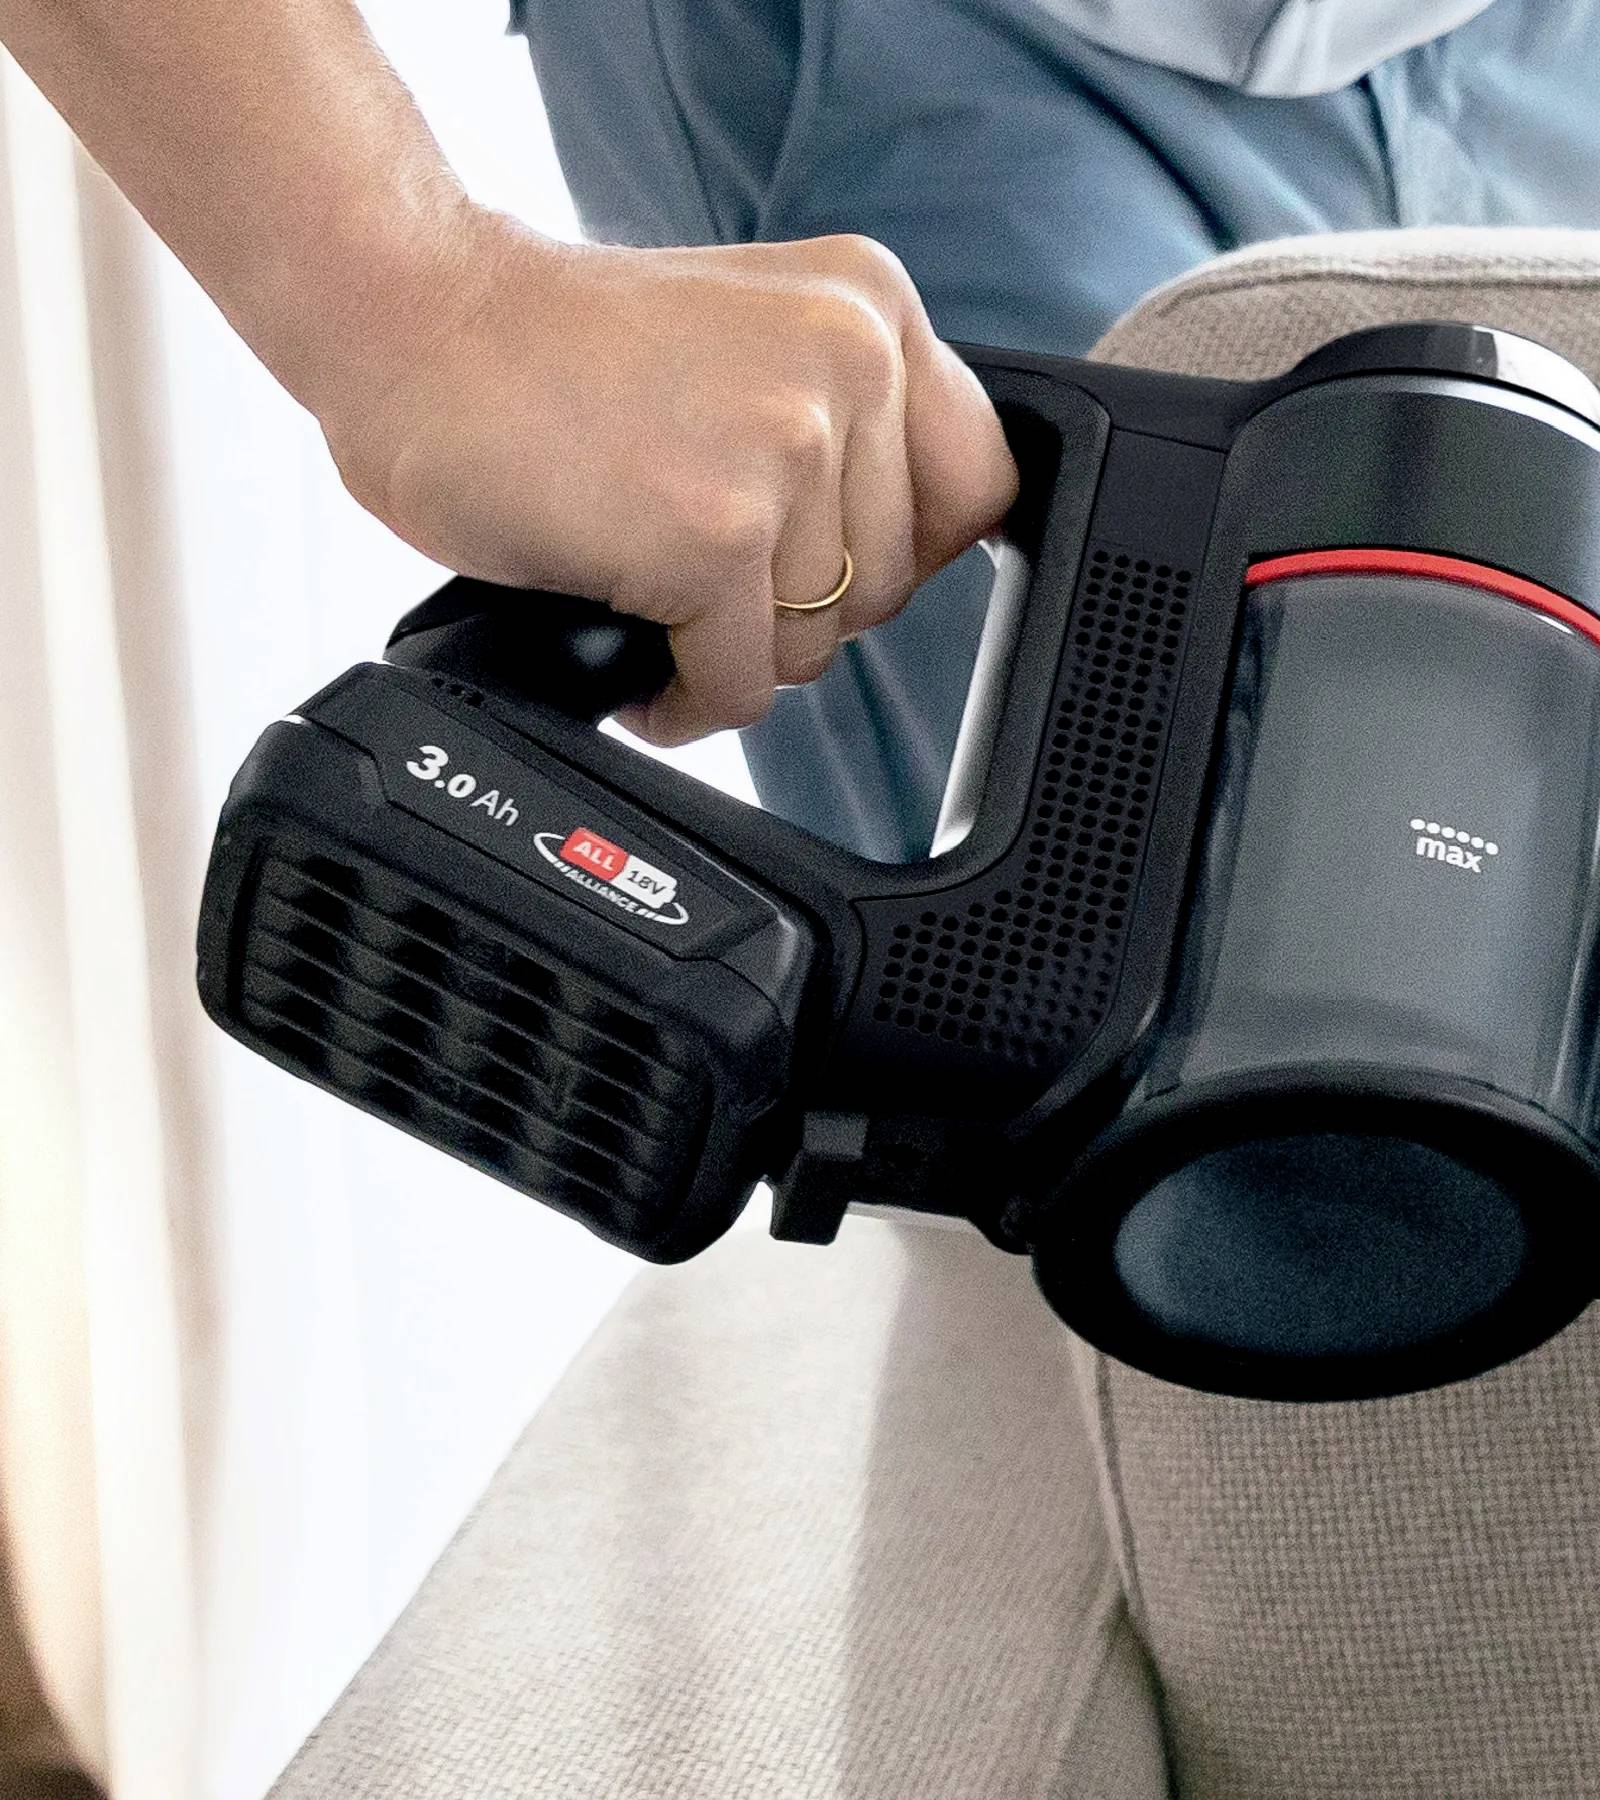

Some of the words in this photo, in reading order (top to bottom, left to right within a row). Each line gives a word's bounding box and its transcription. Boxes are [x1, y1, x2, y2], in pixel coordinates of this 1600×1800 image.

[406, 745, 477, 799] 3.0
[470, 789, 519, 826] Ah
[573, 841, 615, 871] ALL
[627, 870, 666, 895] 18V
[1415, 836, 1483, 873] max
